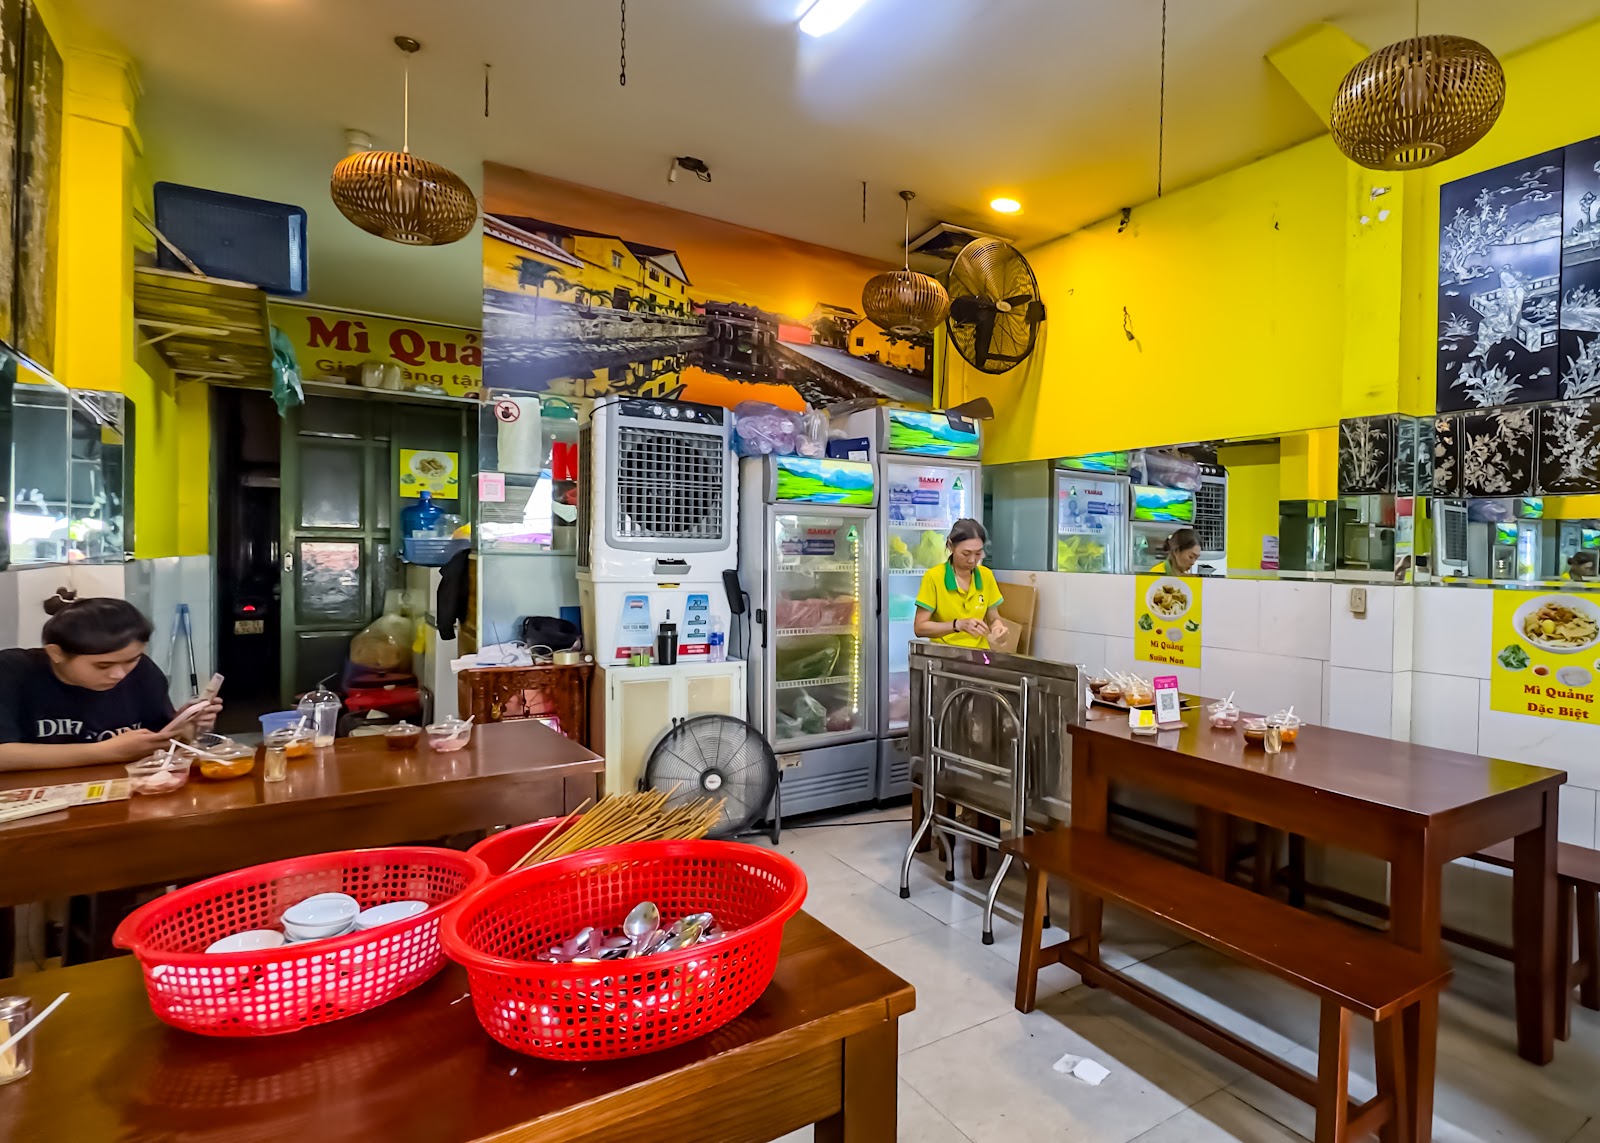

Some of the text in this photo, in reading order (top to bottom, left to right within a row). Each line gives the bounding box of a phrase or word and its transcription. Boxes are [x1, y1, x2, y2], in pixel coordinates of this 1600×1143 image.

[306, 316, 371, 353] Mì
[1524, 684, 1594, 703] Mì Quảng
[1527, 702, 1589, 720] Đặc Biệt
